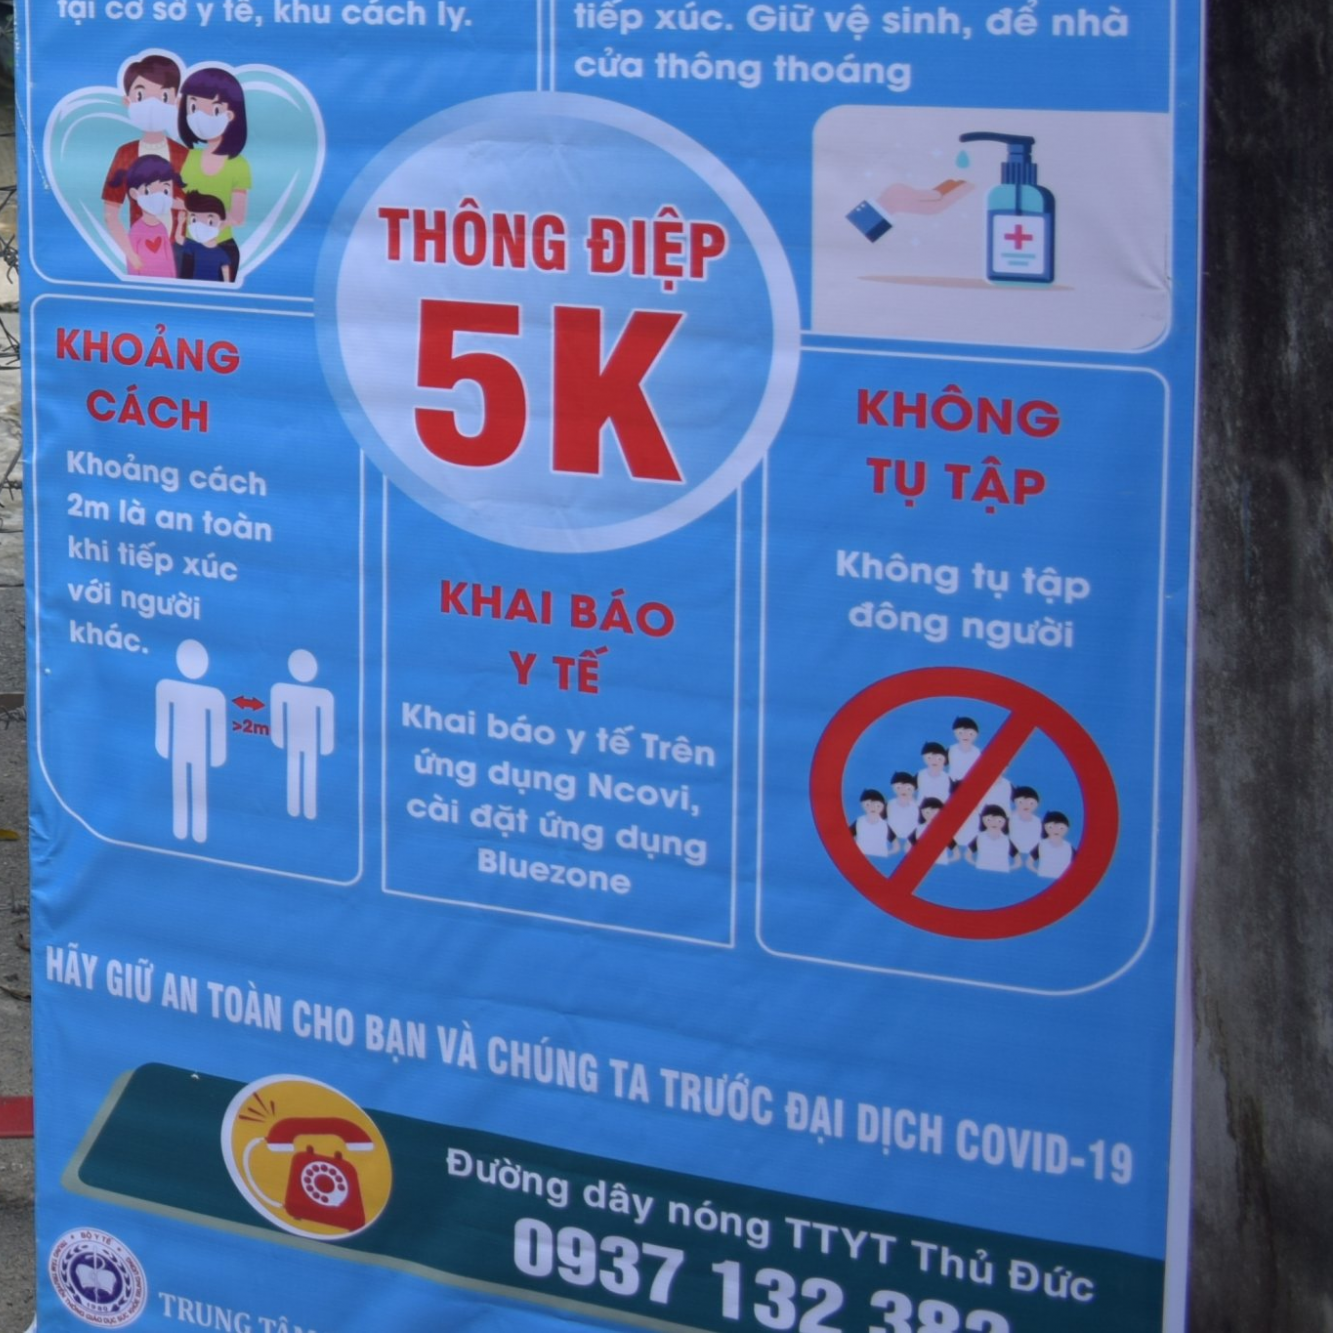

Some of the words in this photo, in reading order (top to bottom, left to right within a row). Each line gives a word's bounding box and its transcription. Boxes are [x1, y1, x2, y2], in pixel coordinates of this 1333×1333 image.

[195, 1, 215, 27] y
[437, 0, 473, 32] ly.
[654, 0, 734, 32] xúc.
[746, 3, 816, 33] Giữ
[823, 3, 871, 41] vệ
[882, 6, 972, 40] sinh,
[1052, 5, 1129, 38] nhà
[574, 46, 645, 79] cửa
[654, 50, 763, 89] thông
[773, 53, 912, 93] thoáng
[378, 197, 566, 271] THÔNG
[586, 206, 726, 291] ĐIỆP
[56, 323, 241, 375] KHOẢNG
[86, 384, 209, 433] CÁCH
[415, 299, 683, 482] 5K
[857, 384, 1061, 439] KHÔNG
[66, 450, 180, 493] Khoảng
[188, 465, 268, 497] cách
[867, 457, 927, 508] TỤ
[944, 455, 1046, 515] TẬP
[67, 492, 110, 521] 2m
[119, 498, 147, 526] là
[155, 509, 194, 532] an
[202, 510, 273, 543] toàn
[68, 534, 110, 563] khi
[117, 541, 175, 577] tiếp
[182, 552, 238, 582] xúc
[836, 549, 960, 595] Không
[971, 562, 1010, 600] tụ
[1021, 566, 1091, 605] tập
[67, 578, 112, 605] với
[121, 589, 201, 621] người
[440, 580, 553, 625] KHAI
[571, 588, 675, 638] BÁO
[848, 600, 949, 644] đông
[962, 616, 1074, 650] người
[69, 619, 149, 655] khác.
[509, 650, 537, 686] Y
[552, 646, 609, 695] TẾ
[401, 701, 477, 736] Khai
[487, 712, 557, 746] báo
[566, 728, 587, 755] y
[595, 724, 635, 756] tế
[640, 732, 716, 767] Trên
[414, 747, 478, 788] ứng
[487, 760, 577, 802] dụng
[588, 772, 700, 817] Ncovi,
[406, 793, 460, 824] cài
[469, 803, 529, 839] đặt
[539, 810, 605, 852] ứng
[615, 824, 708, 867] dụng
[477, 847, 632, 895] Bluezone
[46, 942, 99, 990] HÃY
[106, 957, 155, 1004] GIỮ
[161, 972, 198, 1014] AN
[206, 980, 282, 1032] TOÀN
[292, 999, 355, 1047] CHO
[365, 1013, 427, 1063] BẠN
[436, 1020, 478, 1070] VÀ
[487, 1035, 599, 1093] CHÚNG
[609, 1058, 650, 1104] TA
[659, 1067, 773, 1126] TRƯỚC
[784, 1091, 844, 1144] ĐẠI
[857, 1102, 943, 1155] DỊCH
[956, 1118, 1133, 1185] COVID-19
[445, 1147, 569, 1208] Đường
[583, 1179, 655, 1225] dây
[668, 1200, 770, 1250] nóng
[784, 1216, 897, 1265] TTYT
[910, 1239, 994, 1285] Thủ
[1008, 1259, 1094, 1302] Đức
[513, 1216, 686, 1306] 0937
[712, 1260, 843, 1333] 132
[159, 1292, 251, 1333] TRUNG
